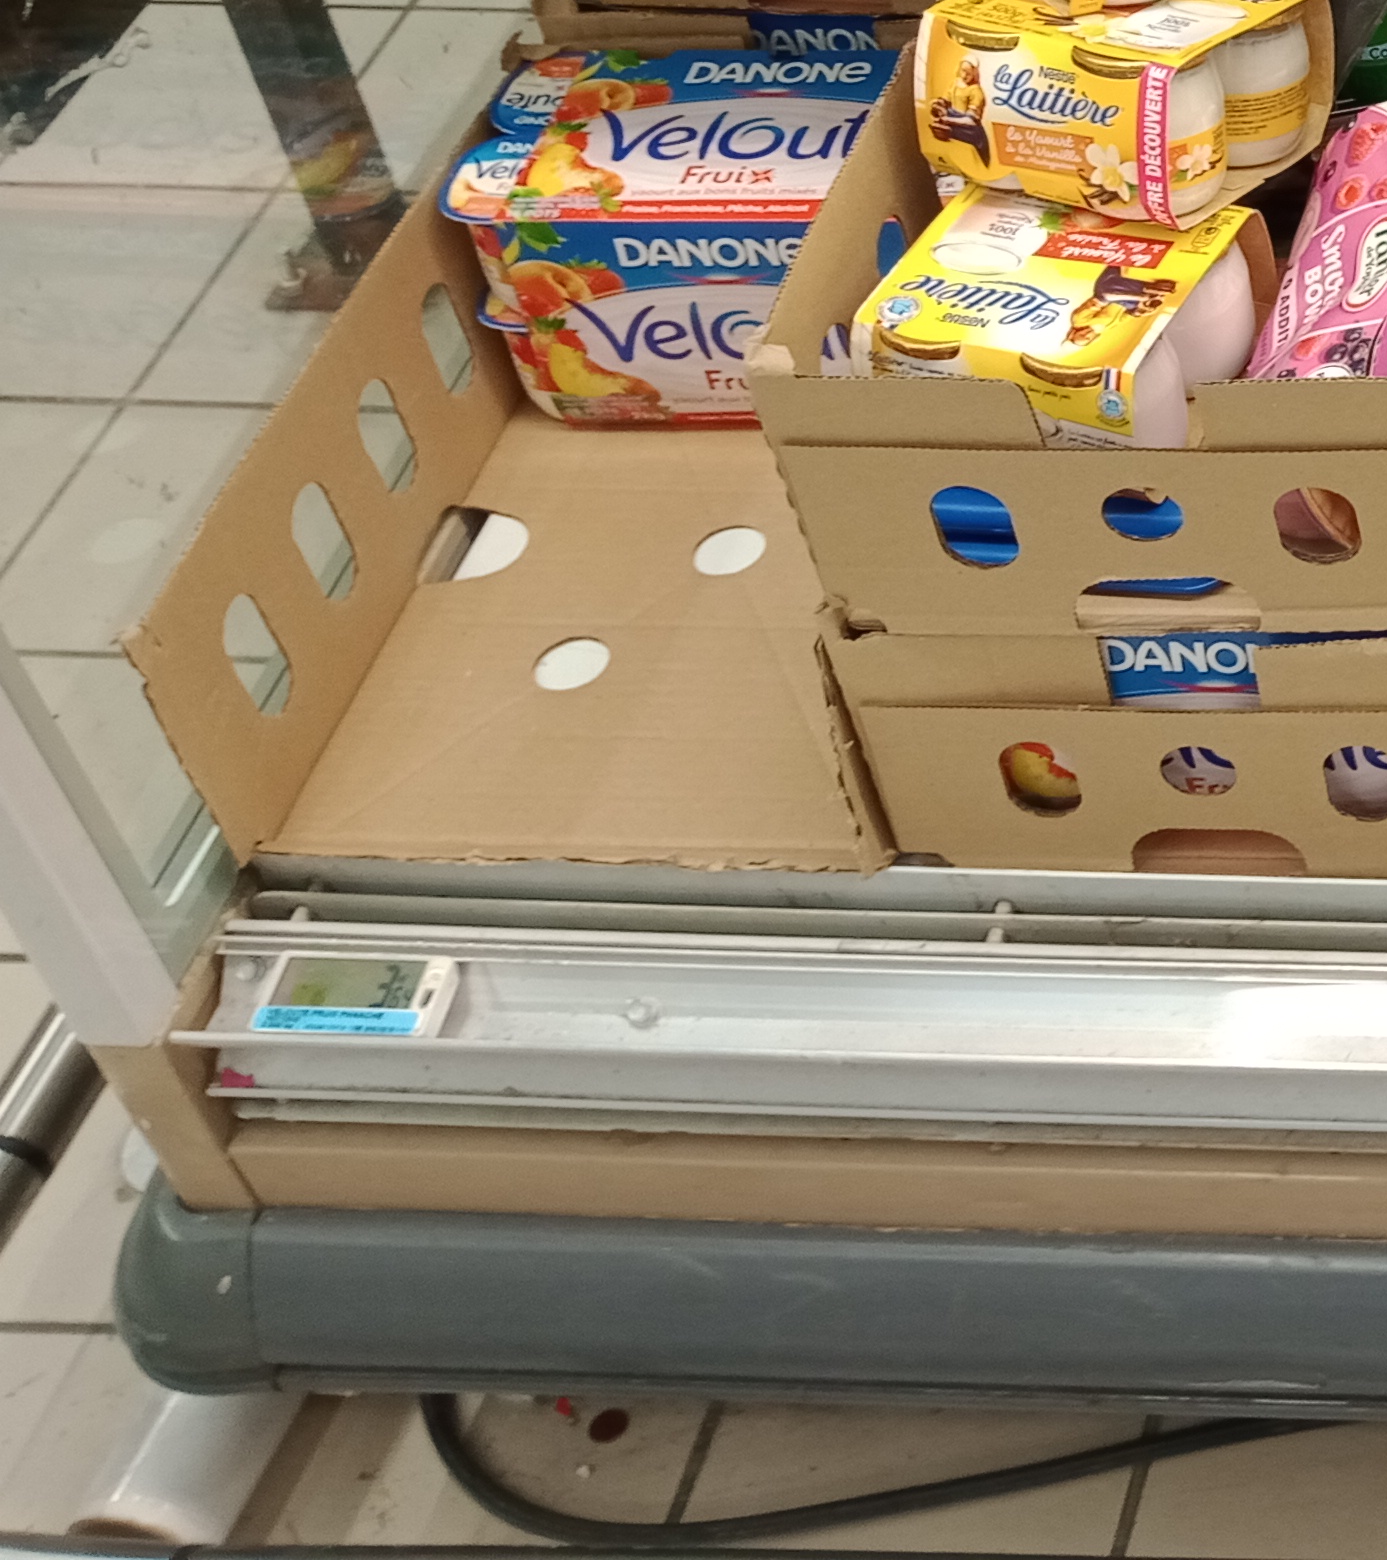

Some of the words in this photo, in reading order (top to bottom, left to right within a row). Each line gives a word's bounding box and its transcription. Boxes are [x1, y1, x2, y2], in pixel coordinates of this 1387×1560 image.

[601, 110, 869, 162] Velout
[1139, 66, 1169, 179] DÉCOUVERTE
[1140, 180, 1173, 227] OFFRE
